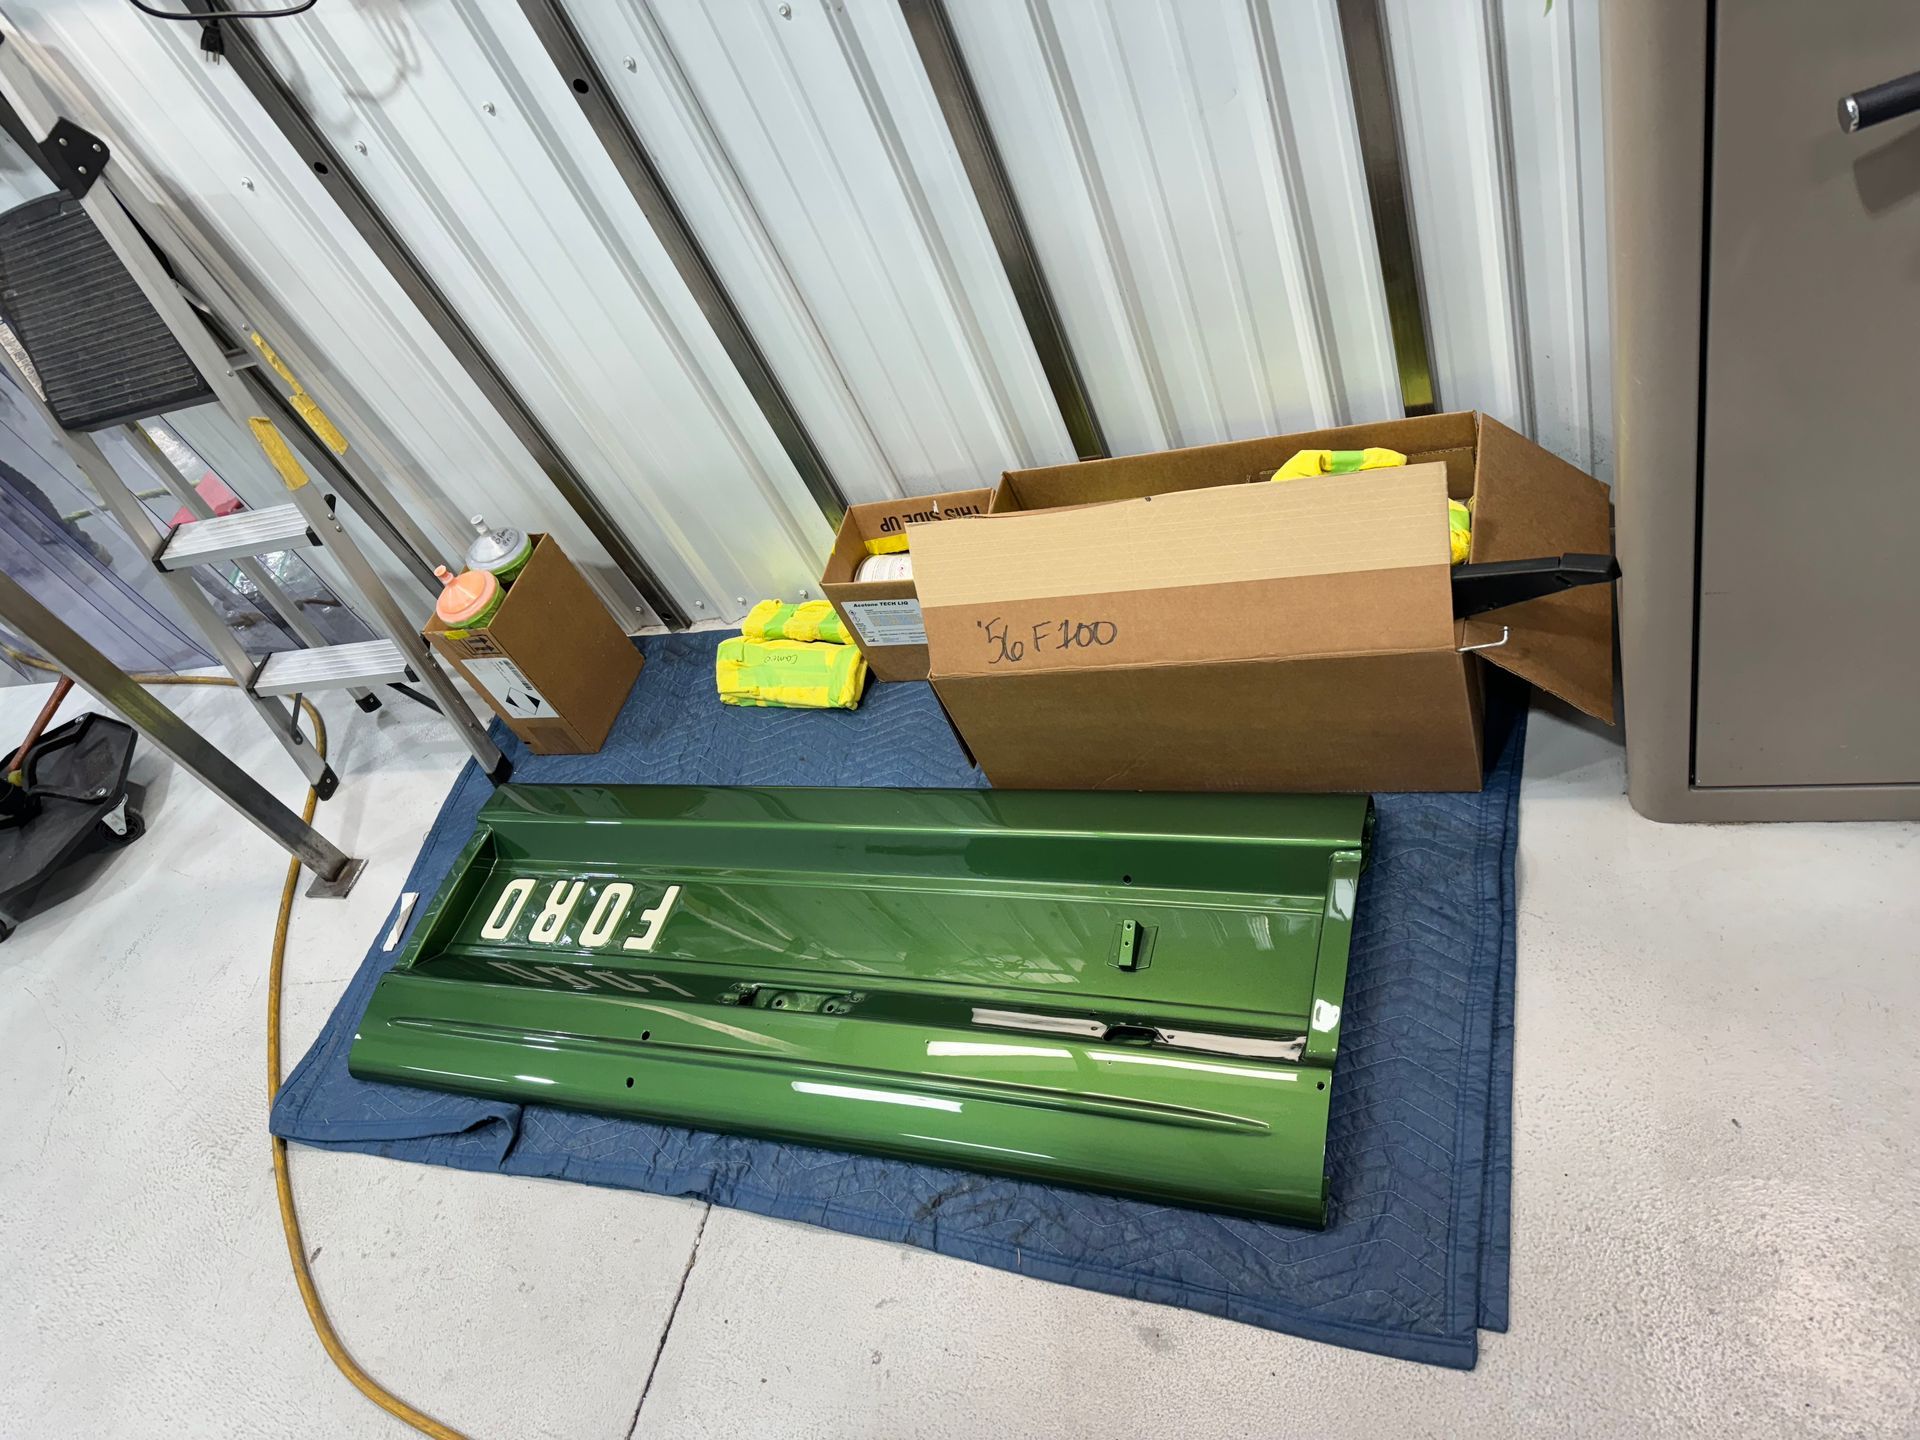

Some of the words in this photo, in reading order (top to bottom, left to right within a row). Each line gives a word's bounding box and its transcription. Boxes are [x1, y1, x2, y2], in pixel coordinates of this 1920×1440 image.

[880, 516, 902, 532] UP
[902, 511, 942, 523] SIDE
[480, 878, 681, 951] FORD
